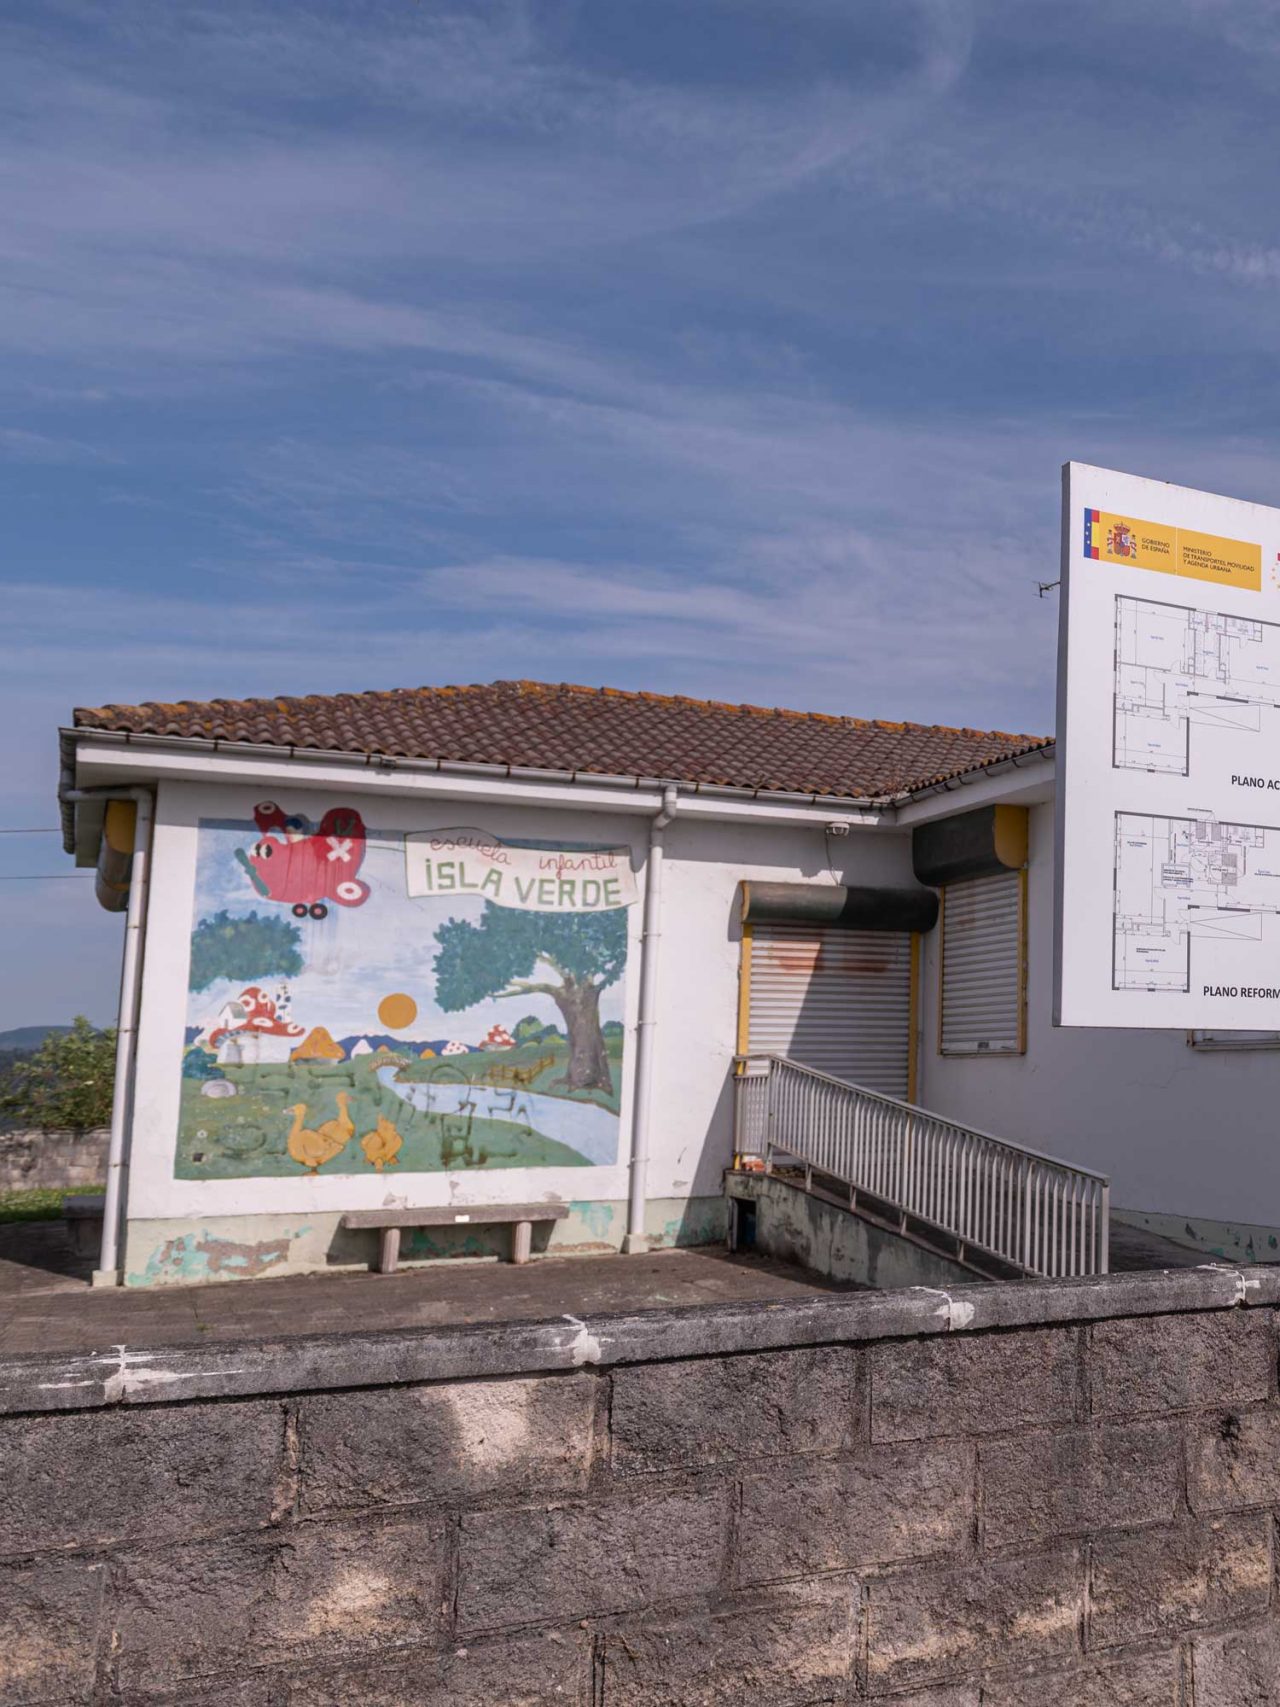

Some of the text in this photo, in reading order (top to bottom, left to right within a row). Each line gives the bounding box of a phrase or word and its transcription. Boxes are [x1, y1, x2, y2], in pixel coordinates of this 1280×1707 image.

[1142, 538, 1170, 548] GOBIERNO
[1150, 546, 1170, 554] ESPAÑA
[1183, 546, 1212, 556] MINISTERIO
[1187, 560, 1209, 569] AGENDA
[1210, 564, 1231, 573] URBANA
[1191, 554, 1226, 566] TRANSPORTES,
[1227, 561, 1254, 571] MOVILIDAD
[1231, 775, 1264, 789] PLANO
[430, 836, 617, 880] escuela infantil
[514, 876, 622, 907] VERDE
[1203, 986, 1238, 997] PLANO
